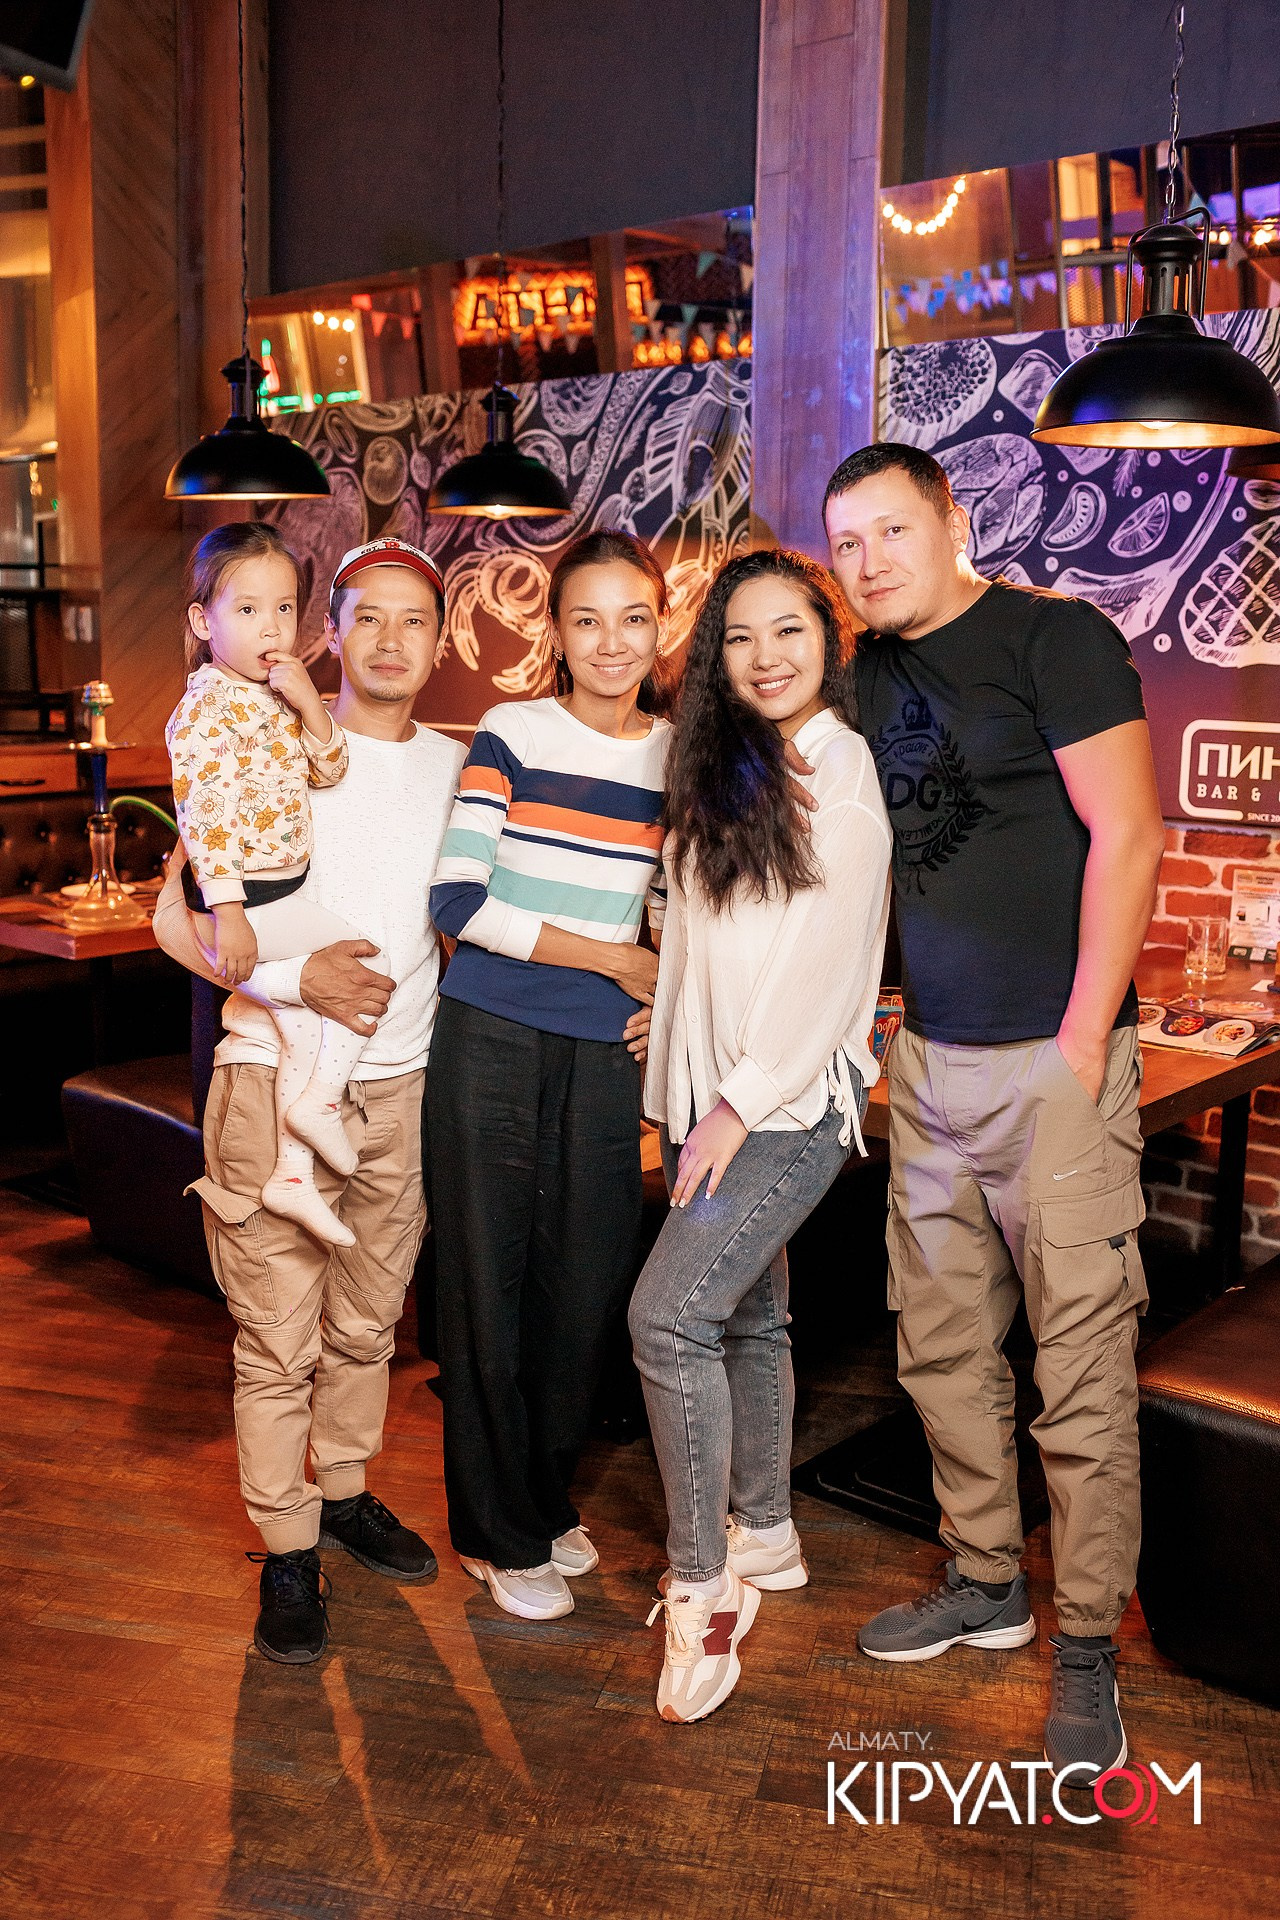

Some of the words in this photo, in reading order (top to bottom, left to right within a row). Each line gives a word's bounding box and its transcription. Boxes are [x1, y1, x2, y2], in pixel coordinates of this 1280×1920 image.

[886, 772, 942, 812] DG
[1196, 783, 1238, 801] BAR
[1251, 787, 1261, 802] &
[1247, 812, 1270, 822] SINCE
